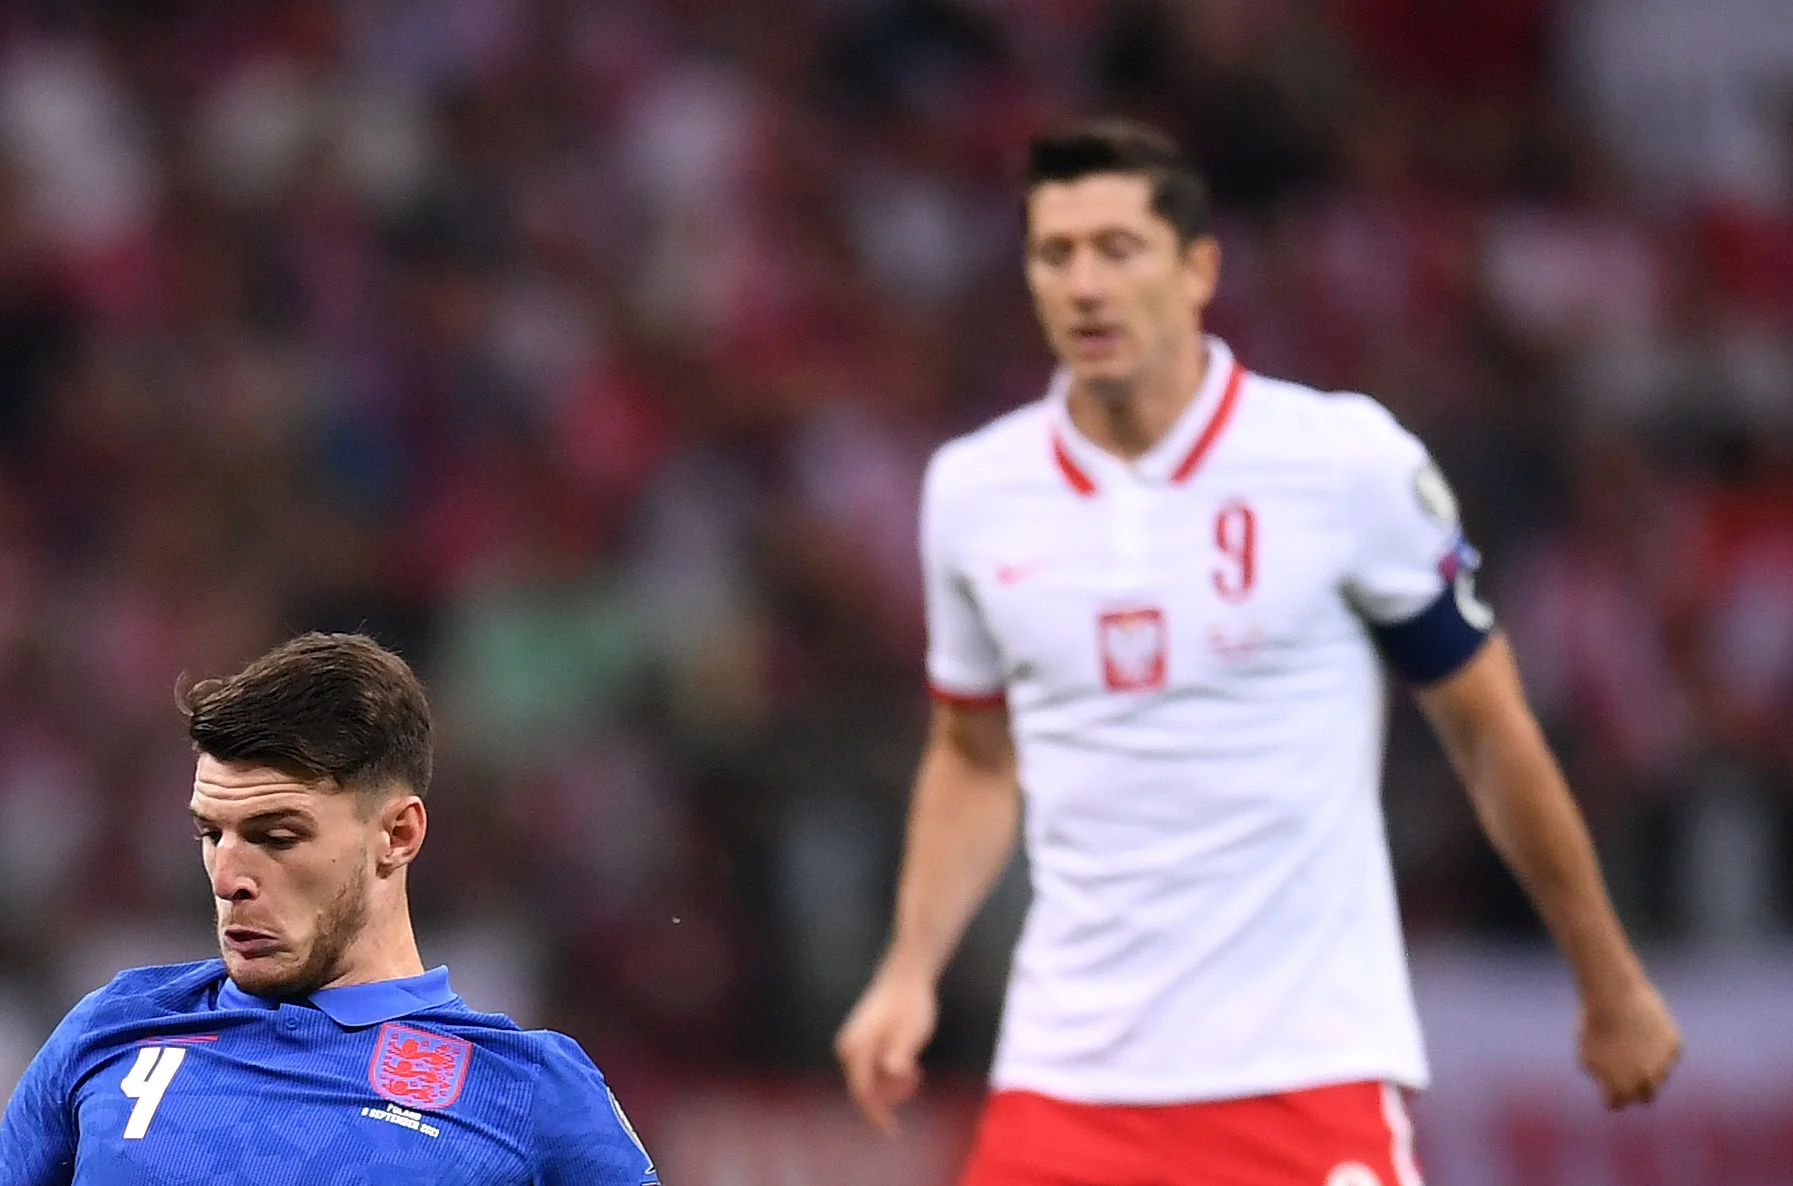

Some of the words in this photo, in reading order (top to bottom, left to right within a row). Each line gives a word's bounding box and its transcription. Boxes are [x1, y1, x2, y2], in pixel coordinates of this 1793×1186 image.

[1212, 501, 1256, 603] 9
[120, 1046, 187, 1139] 4
[368, 1109, 420, 1130] SEPTEMBER
